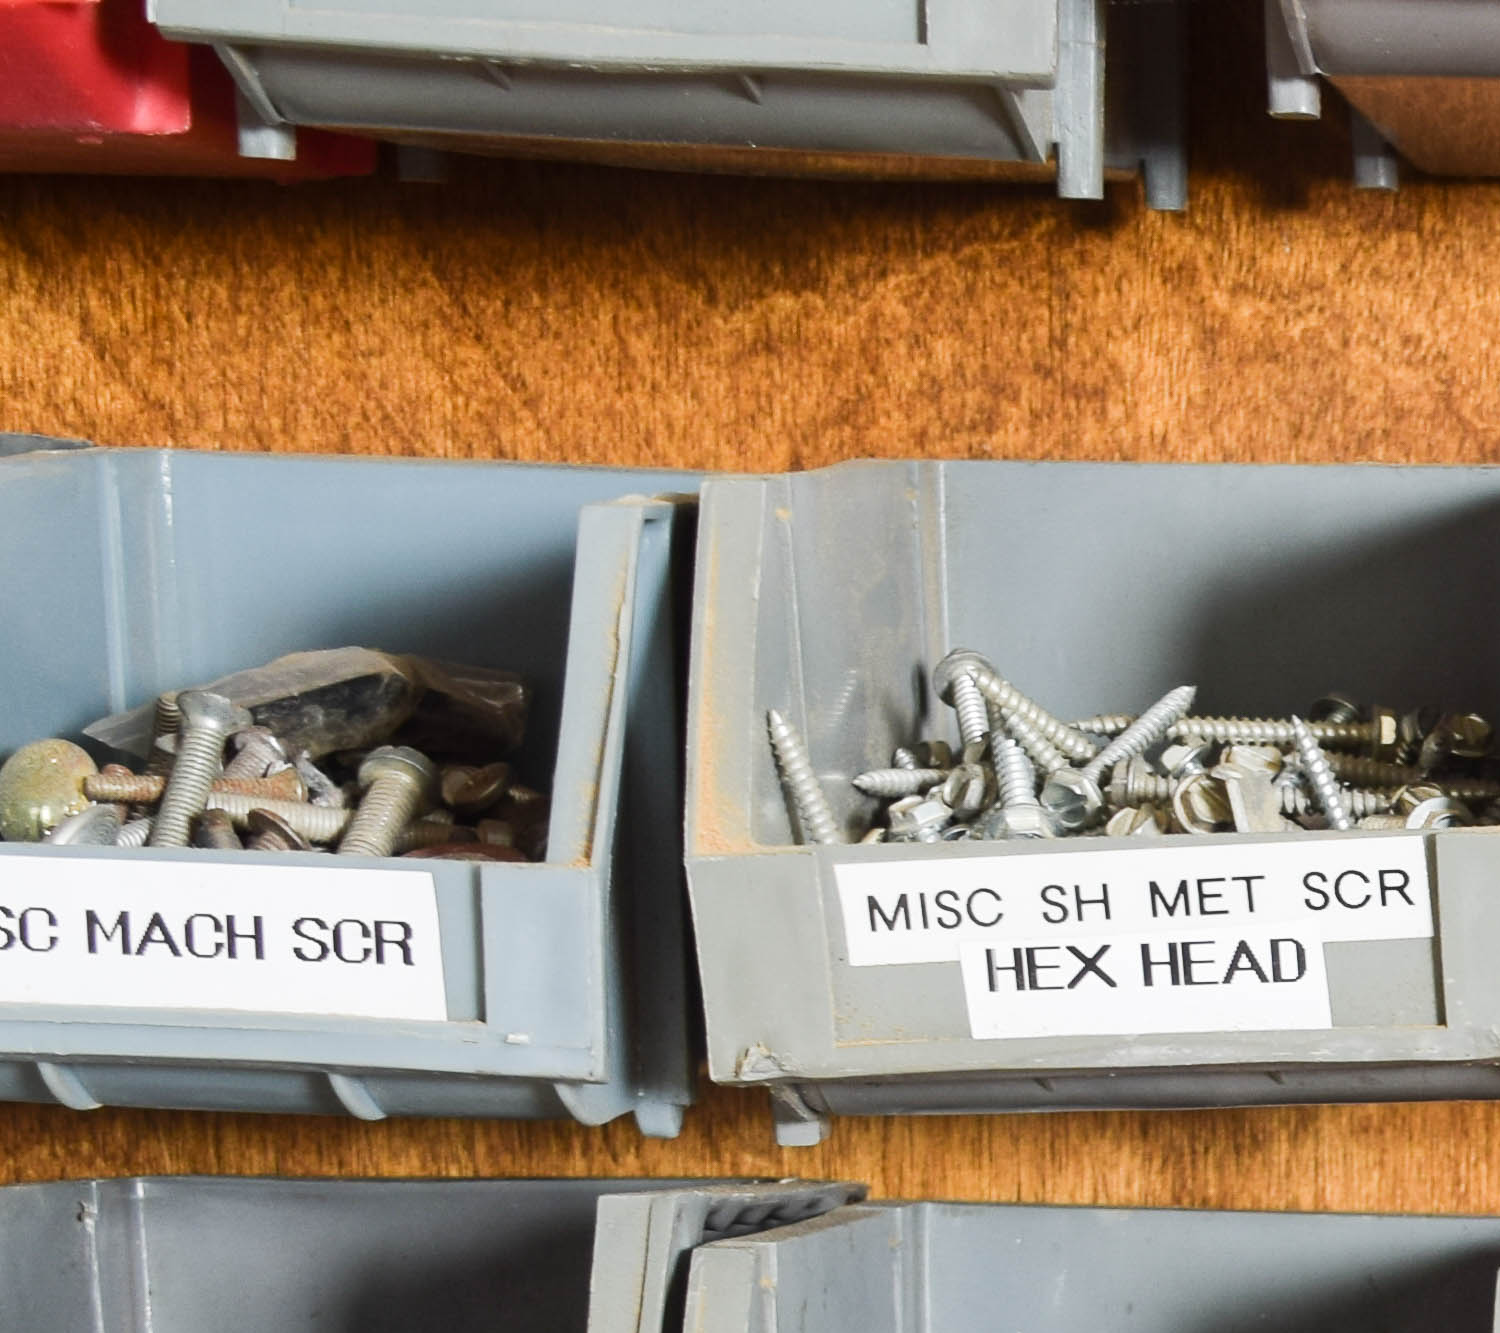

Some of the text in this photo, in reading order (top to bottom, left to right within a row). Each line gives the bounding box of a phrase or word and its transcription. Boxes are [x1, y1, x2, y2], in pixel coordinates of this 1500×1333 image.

[866, 868, 1416, 933] MISC SH MET SCR
[85, 909, 265, 961] MACH
[291, 916, 415, 967] SCR
[984, 937, 1307, 993] HEX HEAD
